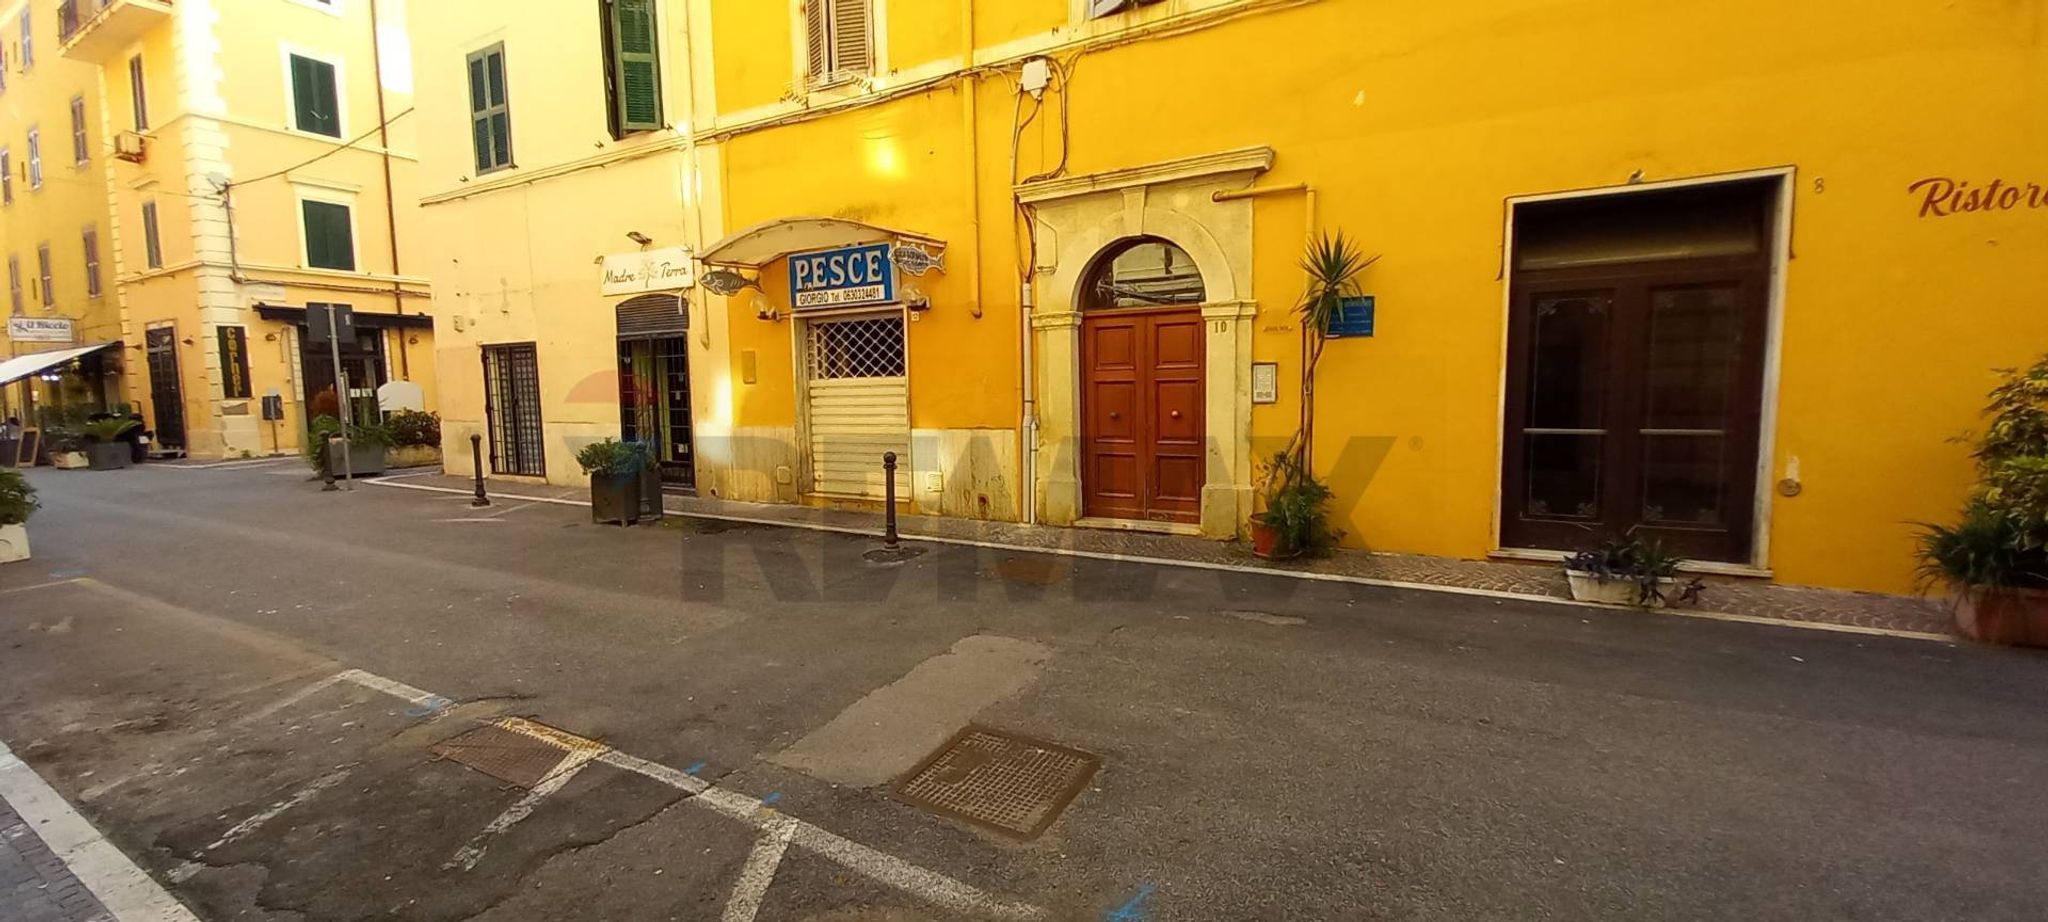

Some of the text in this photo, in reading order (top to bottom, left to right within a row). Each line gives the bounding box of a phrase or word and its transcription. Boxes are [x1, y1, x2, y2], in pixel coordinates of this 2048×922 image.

[1814, 177, 1825, 194] 8
[1908, 177, 2048, 218] Ristor
[603, 262, 688, 285] Madre Terra
[795, 249, 883, 290] PESCE
[799, 291, 829, 305] GIORGIO
[1214, 321, 1227, 333] 10
